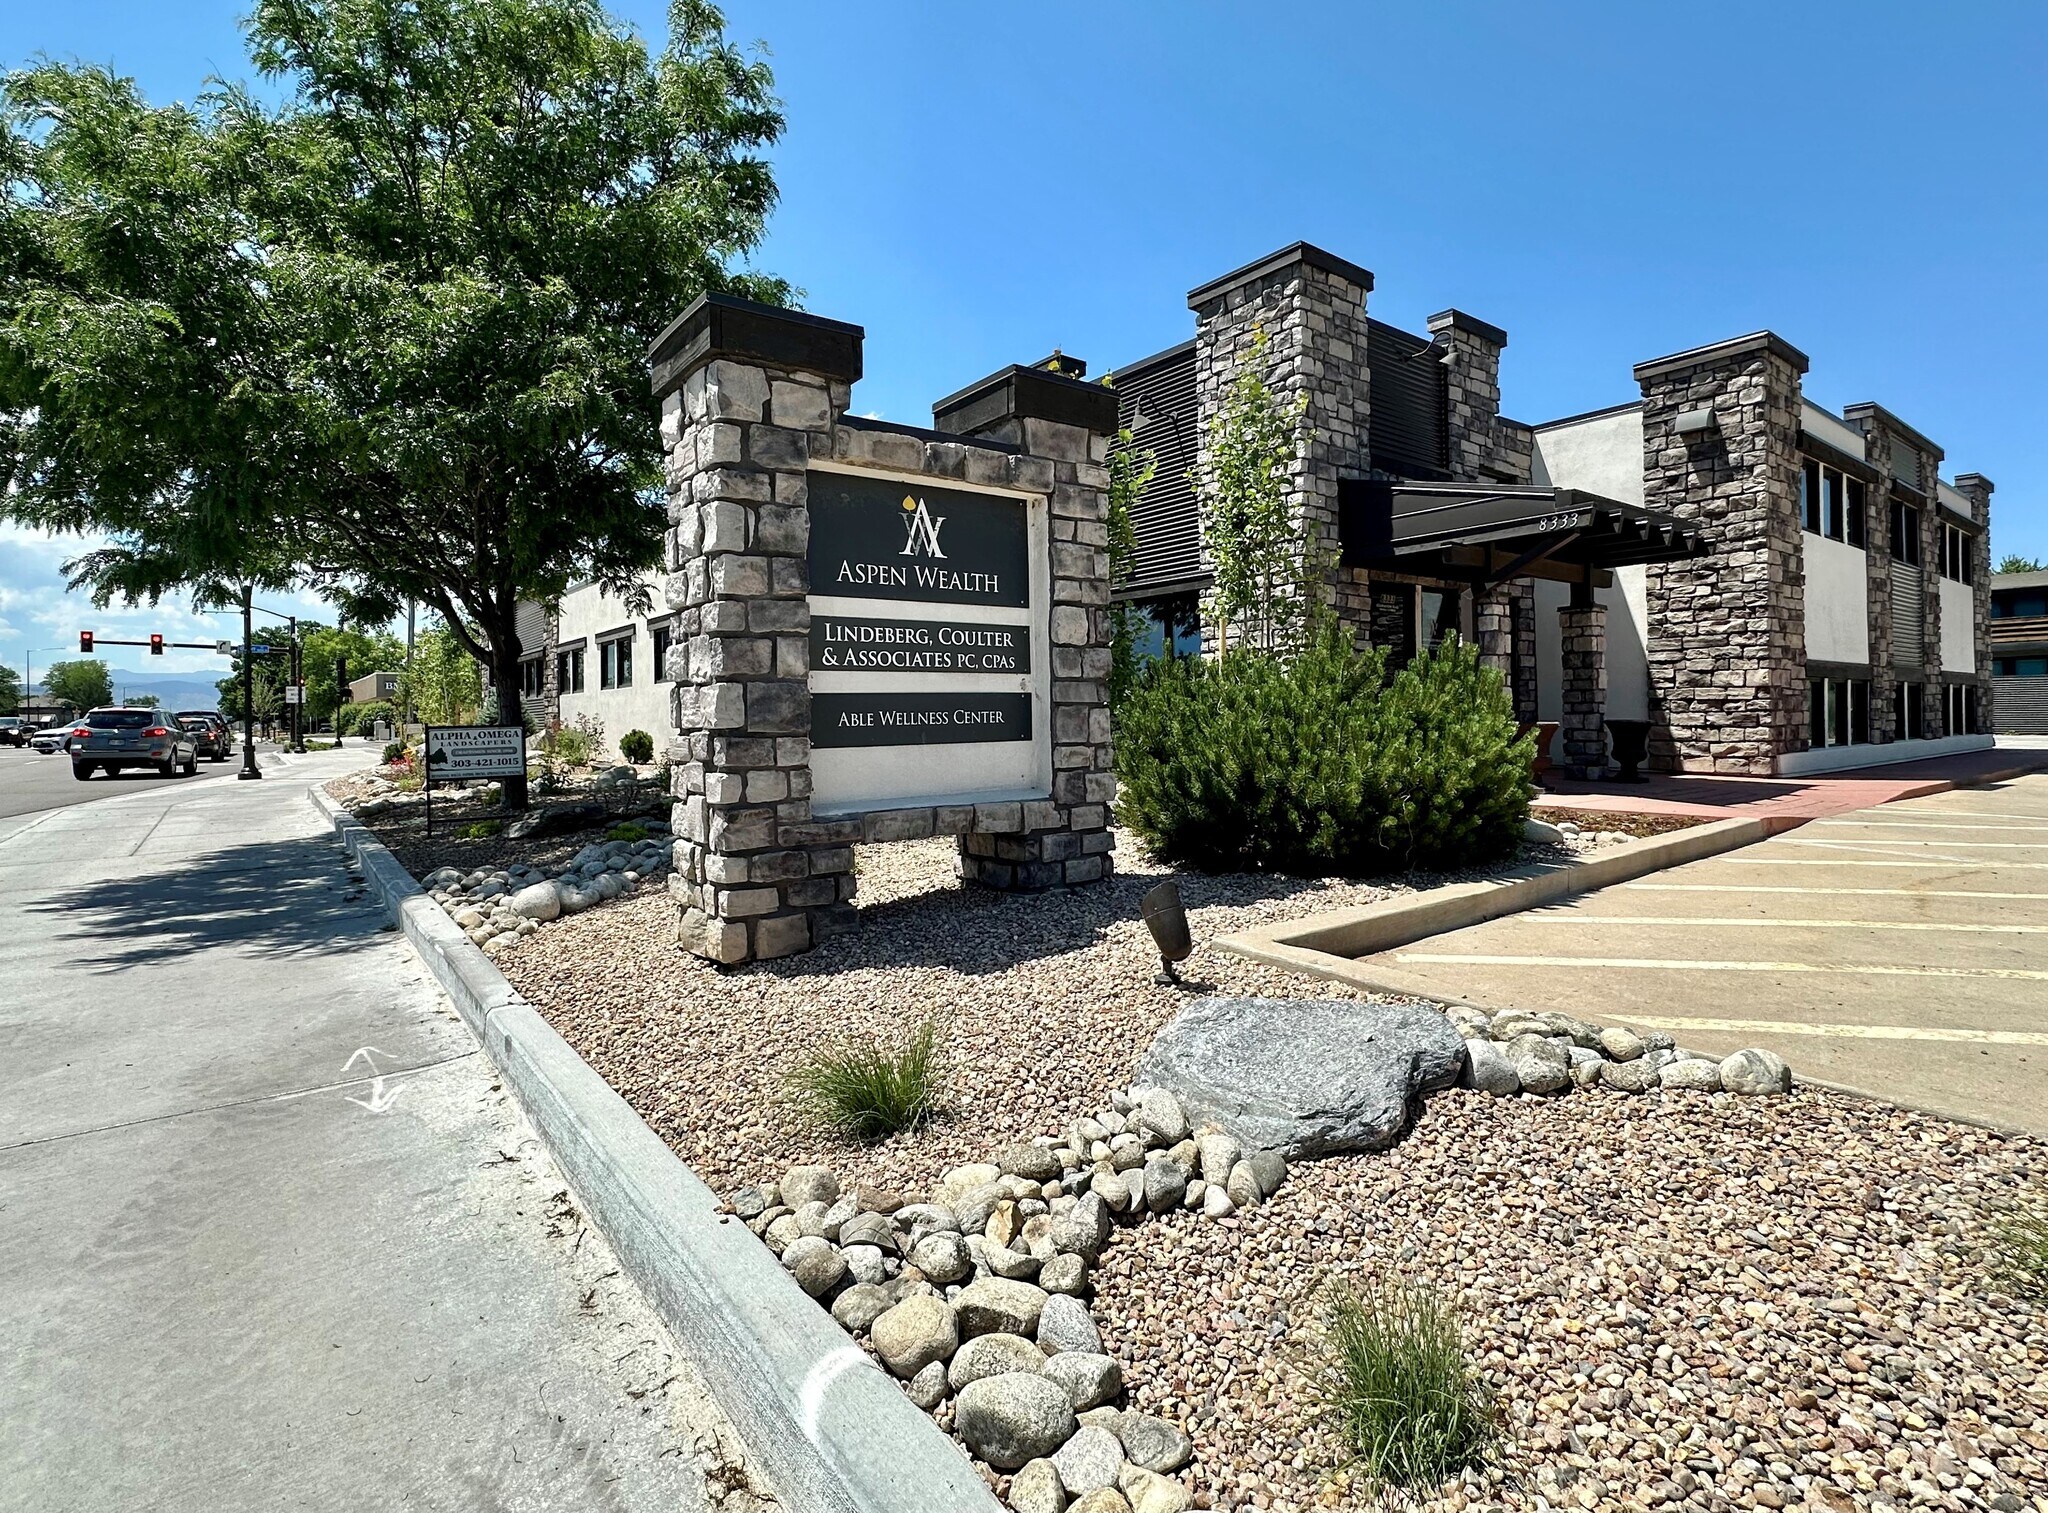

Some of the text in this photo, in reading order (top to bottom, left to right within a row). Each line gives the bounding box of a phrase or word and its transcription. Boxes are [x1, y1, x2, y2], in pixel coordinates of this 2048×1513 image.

[1539, 512, 1578, 531] 8333
[836, 559, 999, 593] ASPEN WEALTH
[824, 622, 1014, 647] LINDEBERG, COULTER
[821, 647, 840, 666] &
[843, 647, 952, 668] ASSOCIATES
[957, 653, 979, 669] PC,
[838, 709, 1005, 727] ABLE WELLNESS CENTER
[432, 732, 471, 740] ALPHA
[478, 731, 519, 739] OMEGA
[451, 758, 519, 768] 303-421-1015
